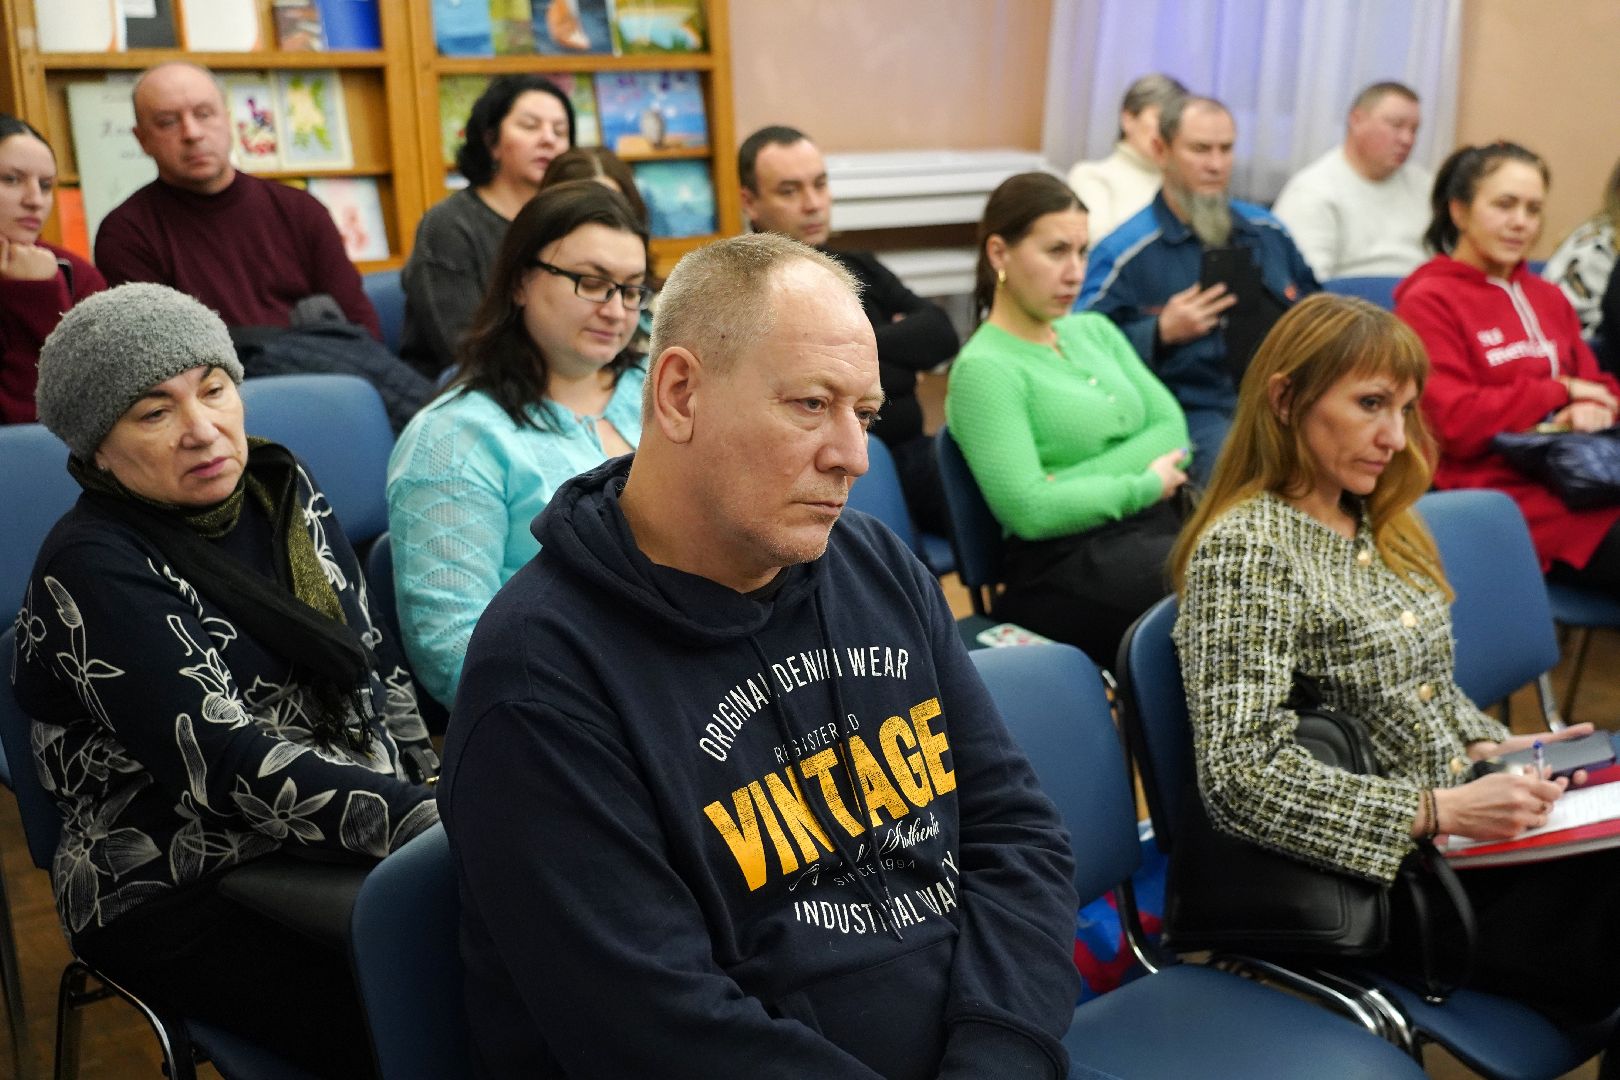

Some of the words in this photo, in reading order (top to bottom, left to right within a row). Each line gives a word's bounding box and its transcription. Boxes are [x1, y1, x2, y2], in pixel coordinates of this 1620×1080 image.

[847, 646, 909, 680] WEAR
[773, 713, 860, 764] RGISTERD
[703, 697, 957, 892] VINTAGE
